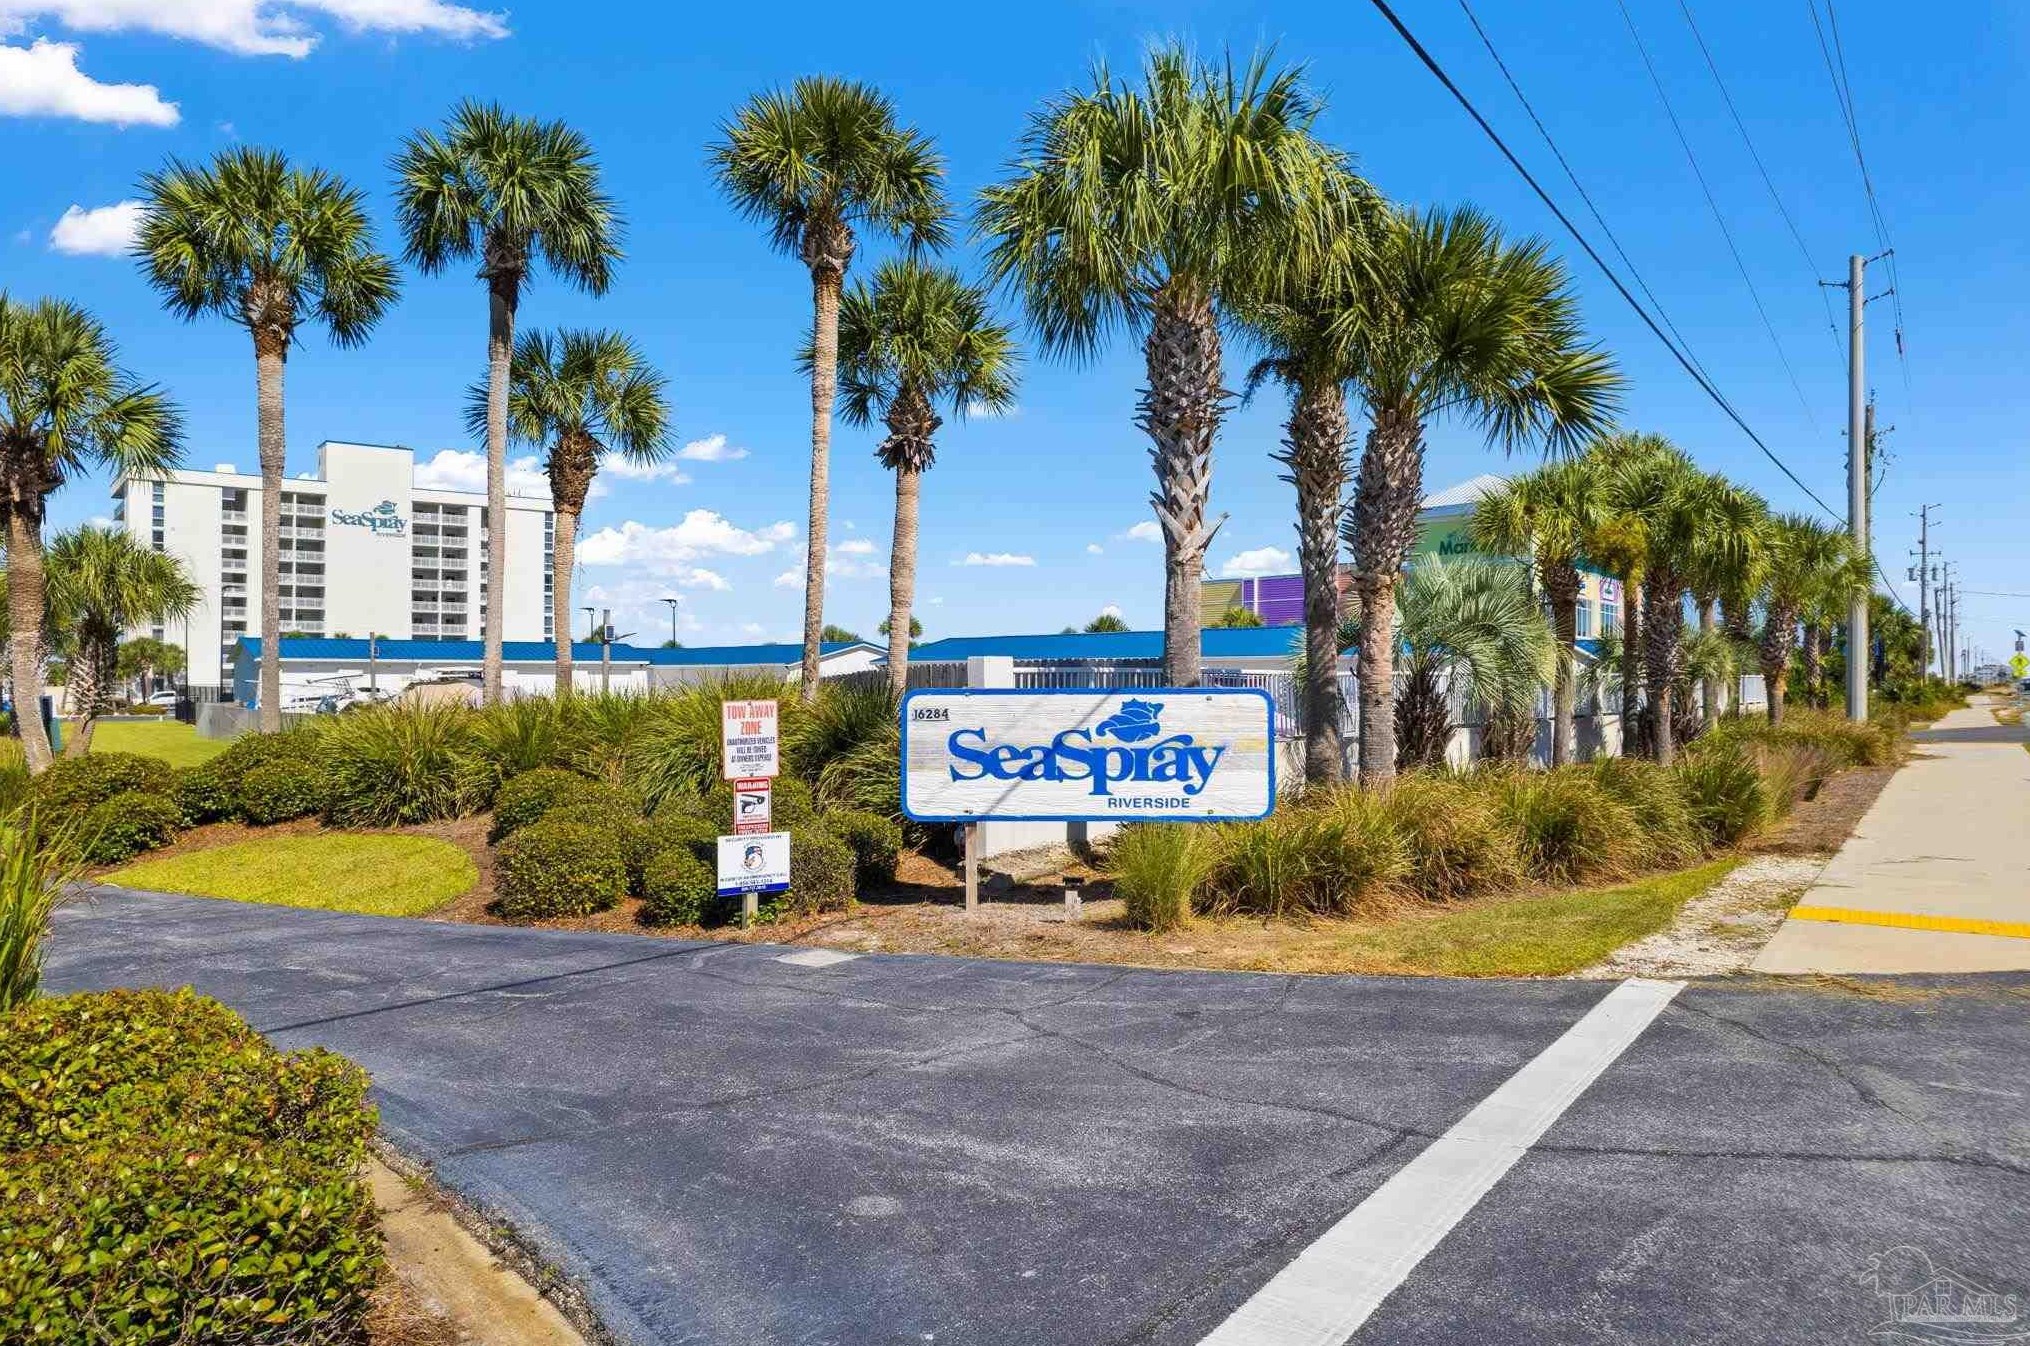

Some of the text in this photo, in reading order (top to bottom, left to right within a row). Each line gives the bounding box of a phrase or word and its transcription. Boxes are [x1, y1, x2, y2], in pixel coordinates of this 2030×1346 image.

[331, 509, 408, 532] SeaSpray
[727, 704, 774, 719] TOW AWAY
[913, 708, 950, 721] 16284
[741, 721, 762, 735] ZONE
[947, 727, 1226, 796] SeaSpray
[736, 781, 768, 791] WARNING
[1107, 797, 1191, 809] RIVERSIDE
